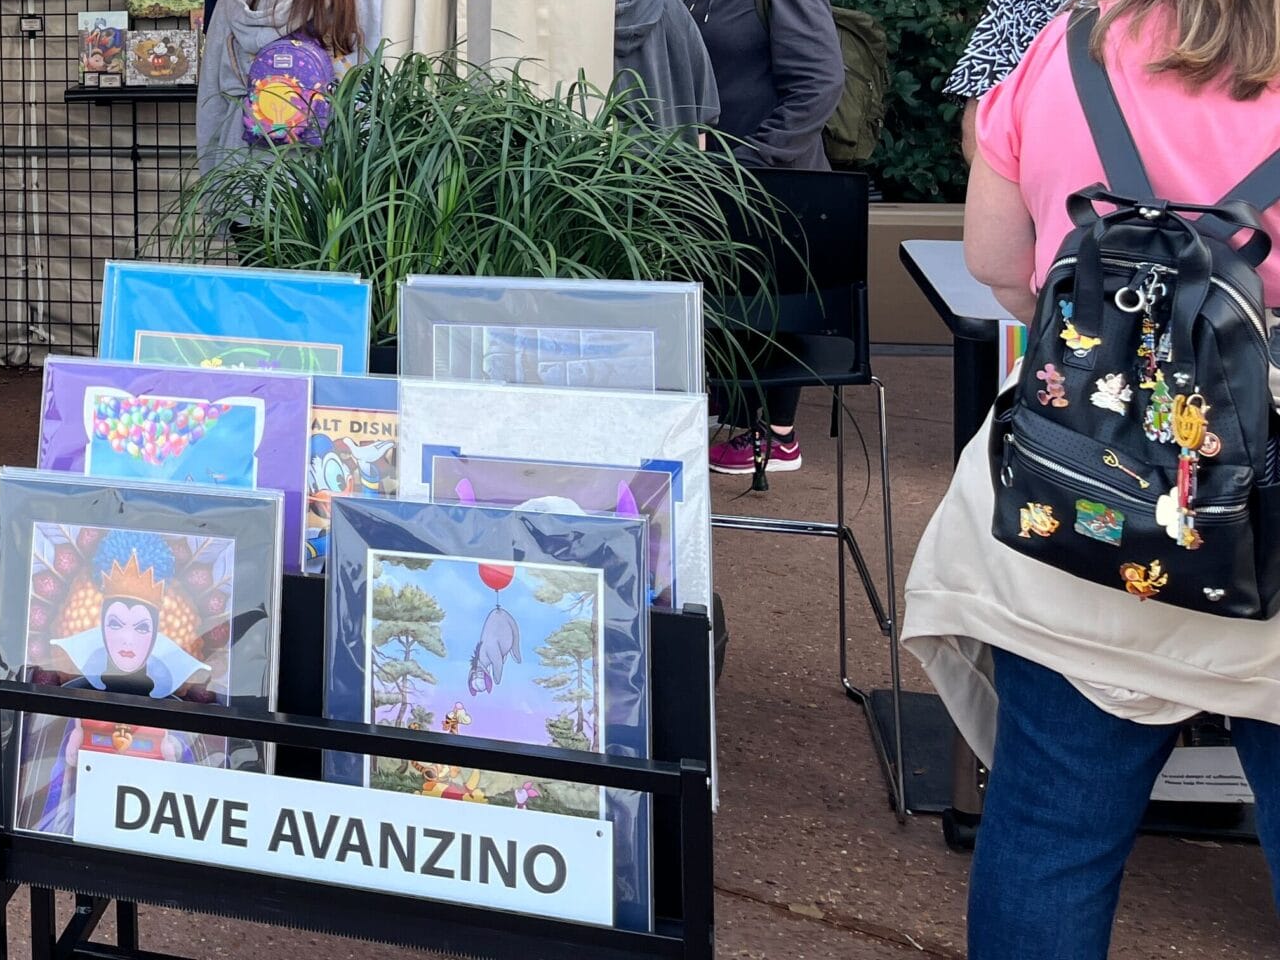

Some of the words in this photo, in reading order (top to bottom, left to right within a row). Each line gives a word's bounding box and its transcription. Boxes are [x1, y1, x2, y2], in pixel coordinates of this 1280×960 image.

[311, 417, 342, 432] ALT
[116, 785, 249, 848] DAVE
[267, 808, 567, 894] AVANZINO
